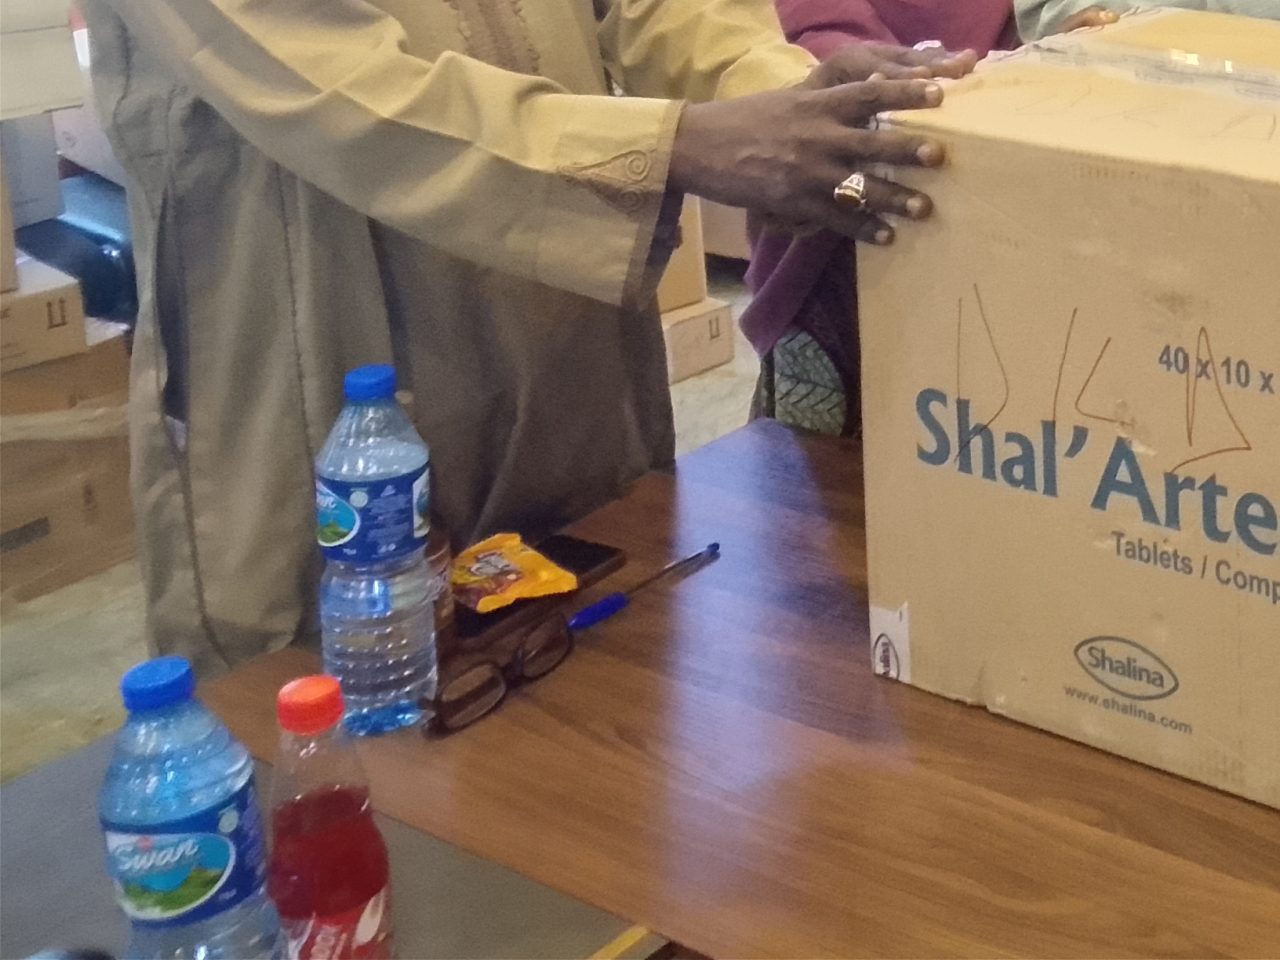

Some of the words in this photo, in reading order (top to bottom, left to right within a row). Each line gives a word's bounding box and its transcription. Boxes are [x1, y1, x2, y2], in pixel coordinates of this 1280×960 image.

[1158, 344, 1189, 374] 40
[1195, 357, 1211, 380] x
[1220, 356, 1250, 388] 10
[1259, 370, 1275, 395] x
[1111, 530, 1193, 575] Tablets
[1087, 645, 1165, 689] Shalina
[1063, 685, 1193, 735] www.shalina.com
[113, 839, 199, 871] Swan
